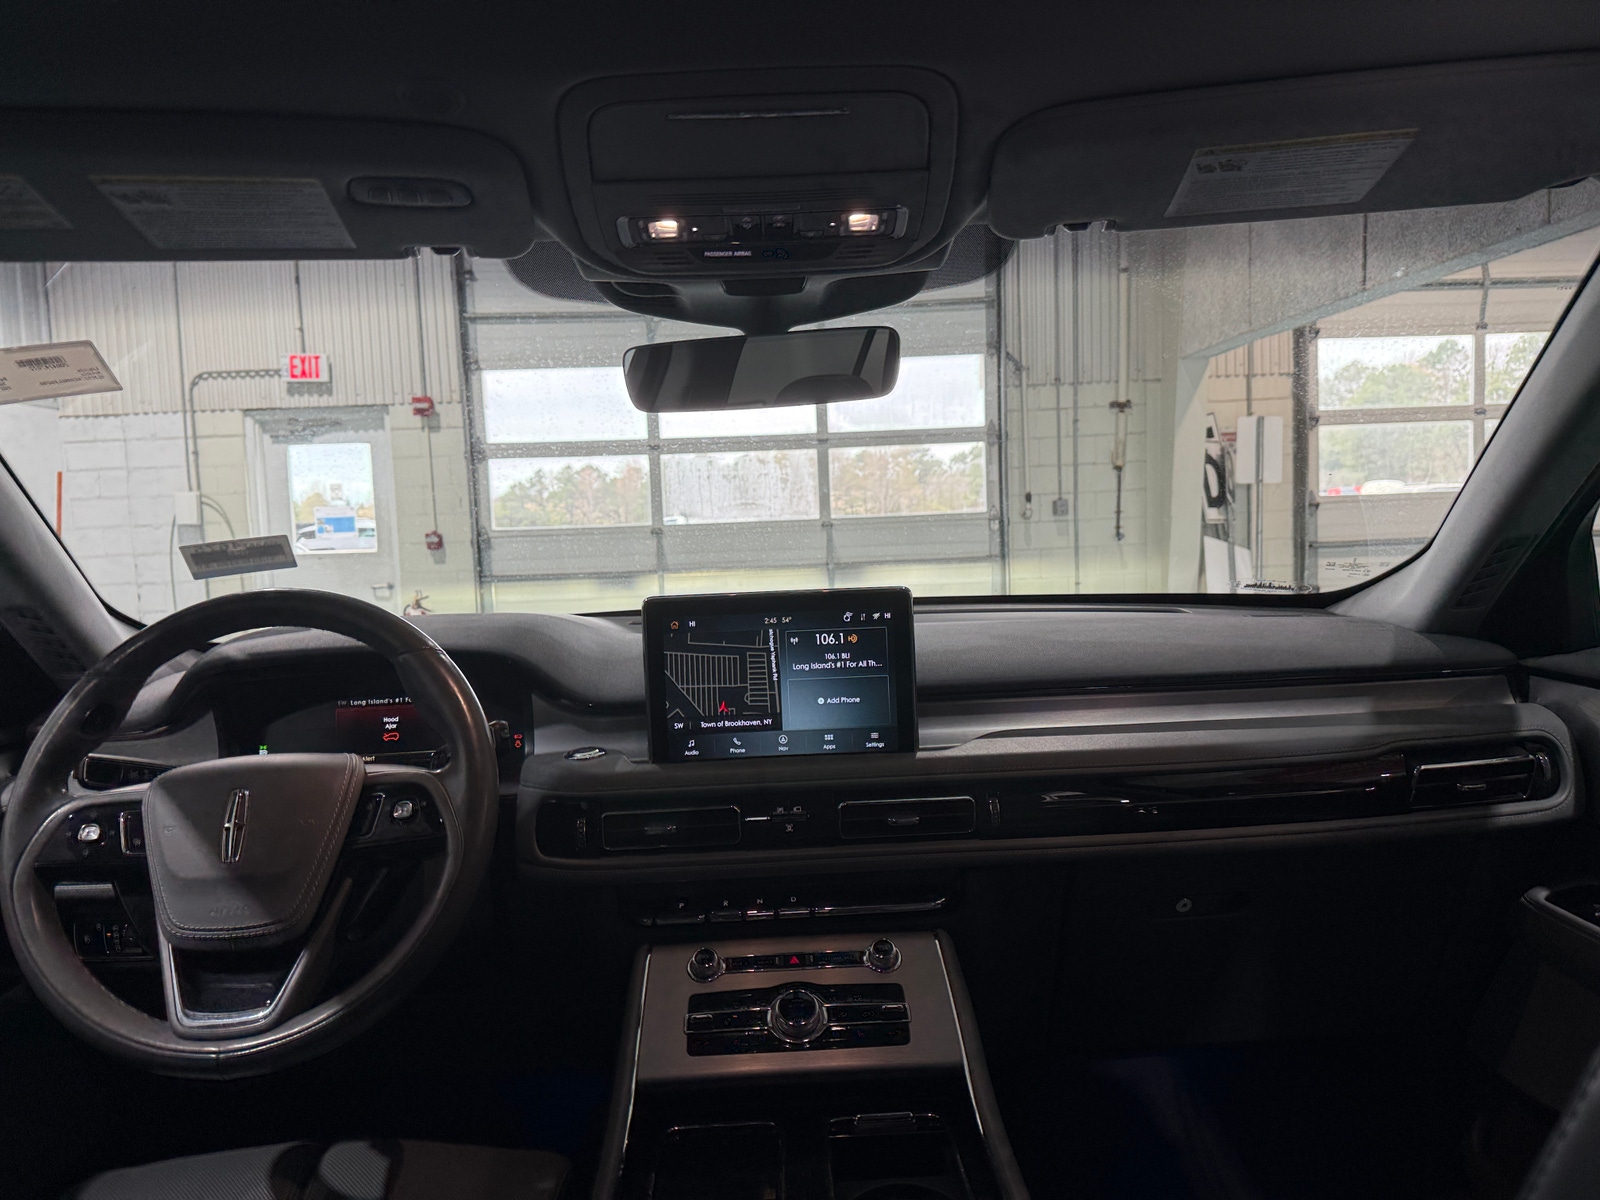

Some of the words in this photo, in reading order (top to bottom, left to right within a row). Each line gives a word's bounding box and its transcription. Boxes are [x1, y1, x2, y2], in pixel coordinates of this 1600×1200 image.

[703, 250, 733, 258] PASSENGER
[289, 355, 321, 379] EXIT
[815, 633, 845, 645] 106.1
[792, 663, 809, 671] Long
[674, 722, 684, 730] SW
